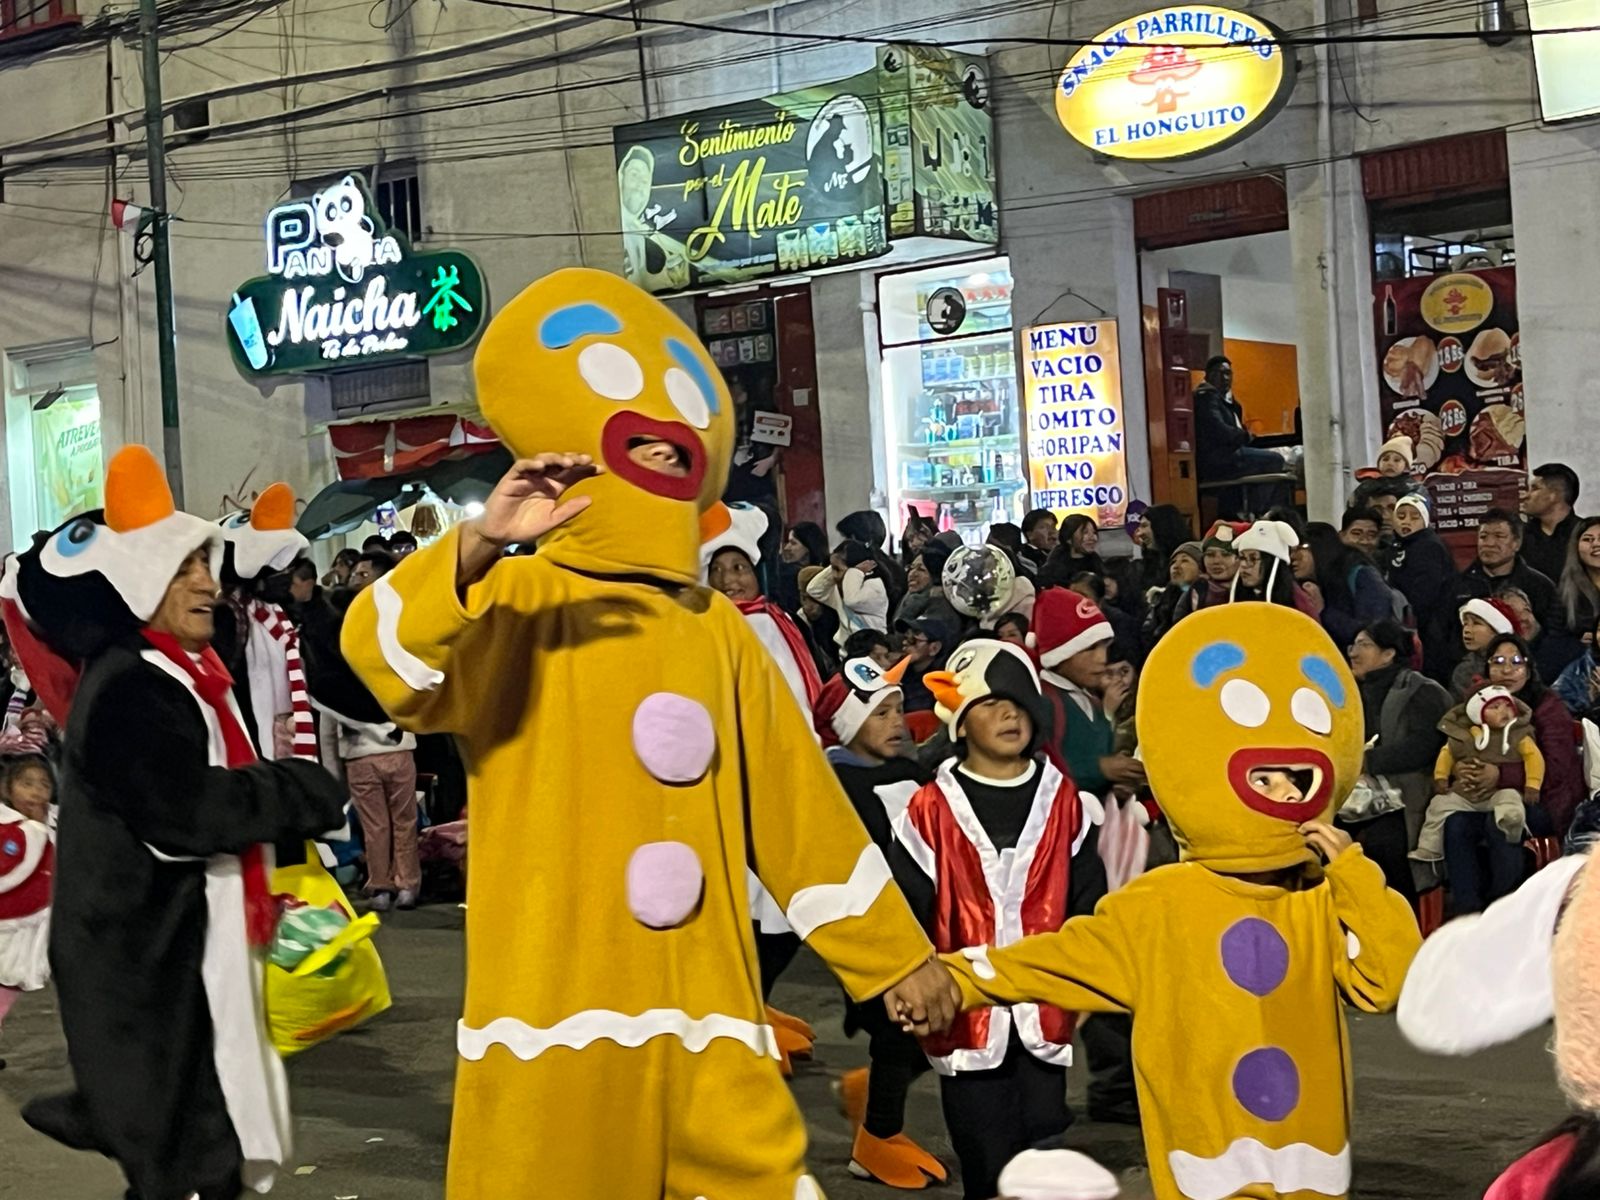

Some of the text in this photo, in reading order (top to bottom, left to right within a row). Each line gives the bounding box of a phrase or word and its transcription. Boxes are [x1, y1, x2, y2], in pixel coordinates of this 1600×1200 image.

[1062, 11, 1273, 96] SNACK PARRILLERO
[679, 111, 797, 166] Sentimiento
[1095, 105, 1246, 146] EL HONGUITO
[684, 164, 725, 201] por el
[687, 156, 805, 261] Mate
[266, 203, 402, 279] PANA
[267, 275, 421, 346] Naicha
[1030, 326, 1097, 351] MENU
[1031, 355, 1103, 378] VACIO
[1038, 382, 1096, 404] TIRA
[1030, 407, 1117, 431] LOMITO
[58, 420, 99, 449] ATREVE
[1030, 433, 1122, 457] CHORIPAN
[1046, 462, 1093, 481] VINO
[1497, 454, 1520, 467] TIRA
